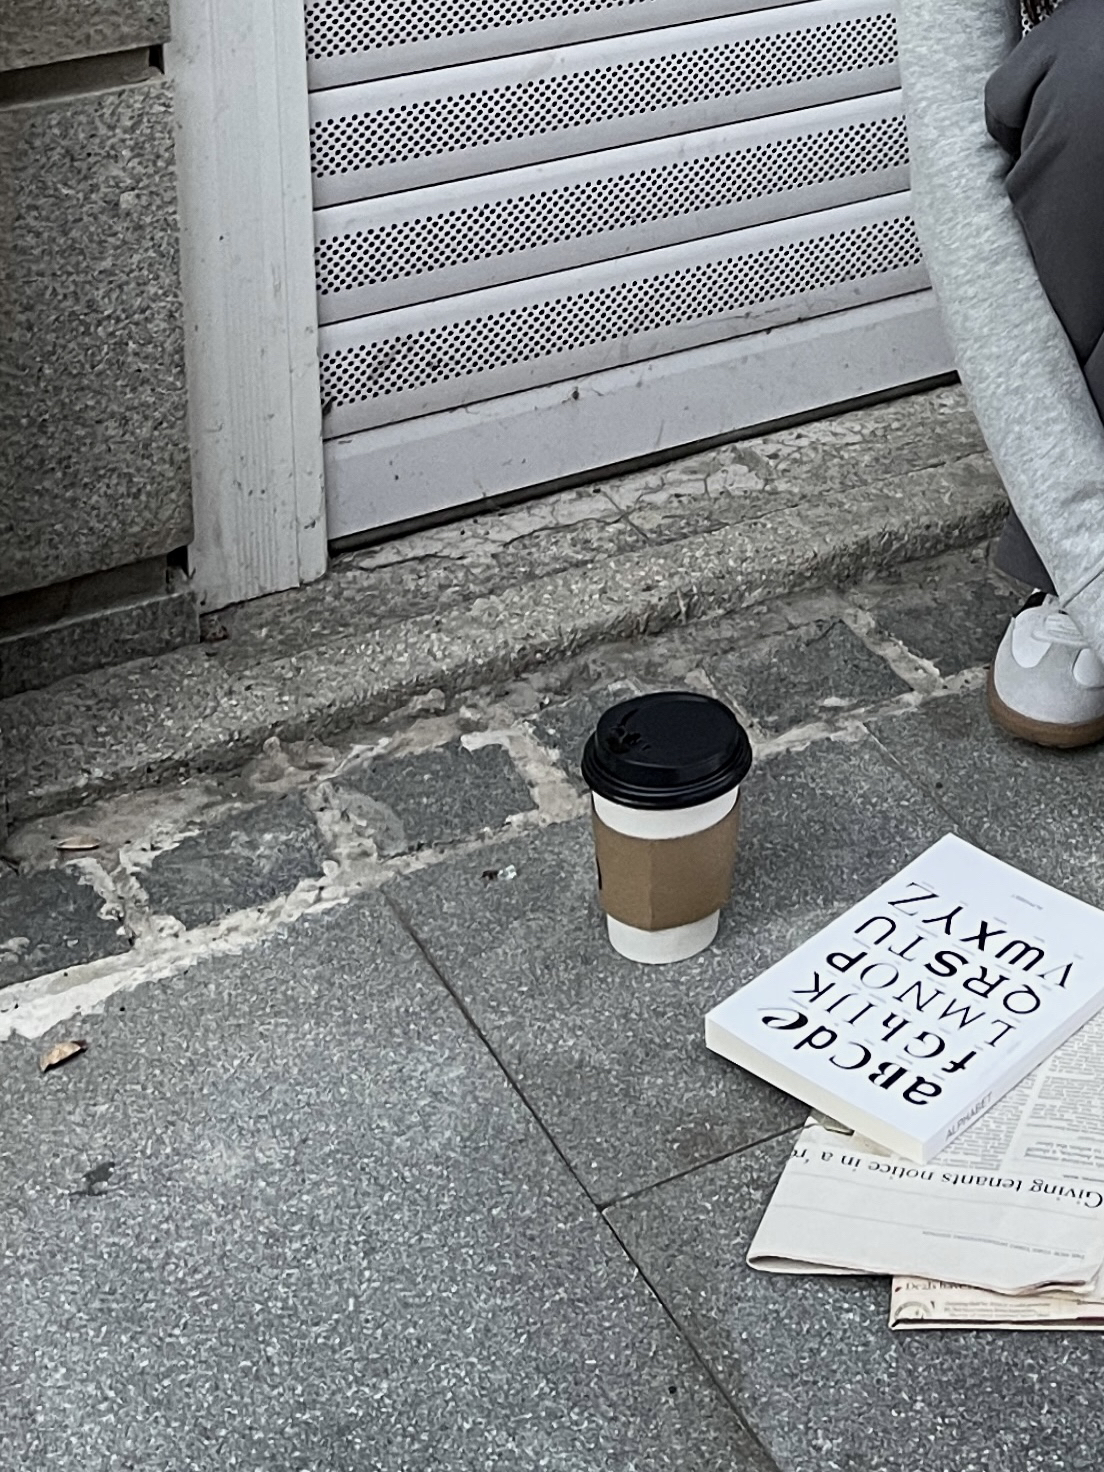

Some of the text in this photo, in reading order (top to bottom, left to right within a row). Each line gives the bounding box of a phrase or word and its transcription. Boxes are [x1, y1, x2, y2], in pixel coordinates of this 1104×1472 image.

[821, 1151, 833, 1162] a
[841, 1155, 861, 1171] in
[868, 1160, 934, 1180] notice
[942, 1173, 1022, 1192] tenants
[1029, 1180, 1103, 1209] Giving
